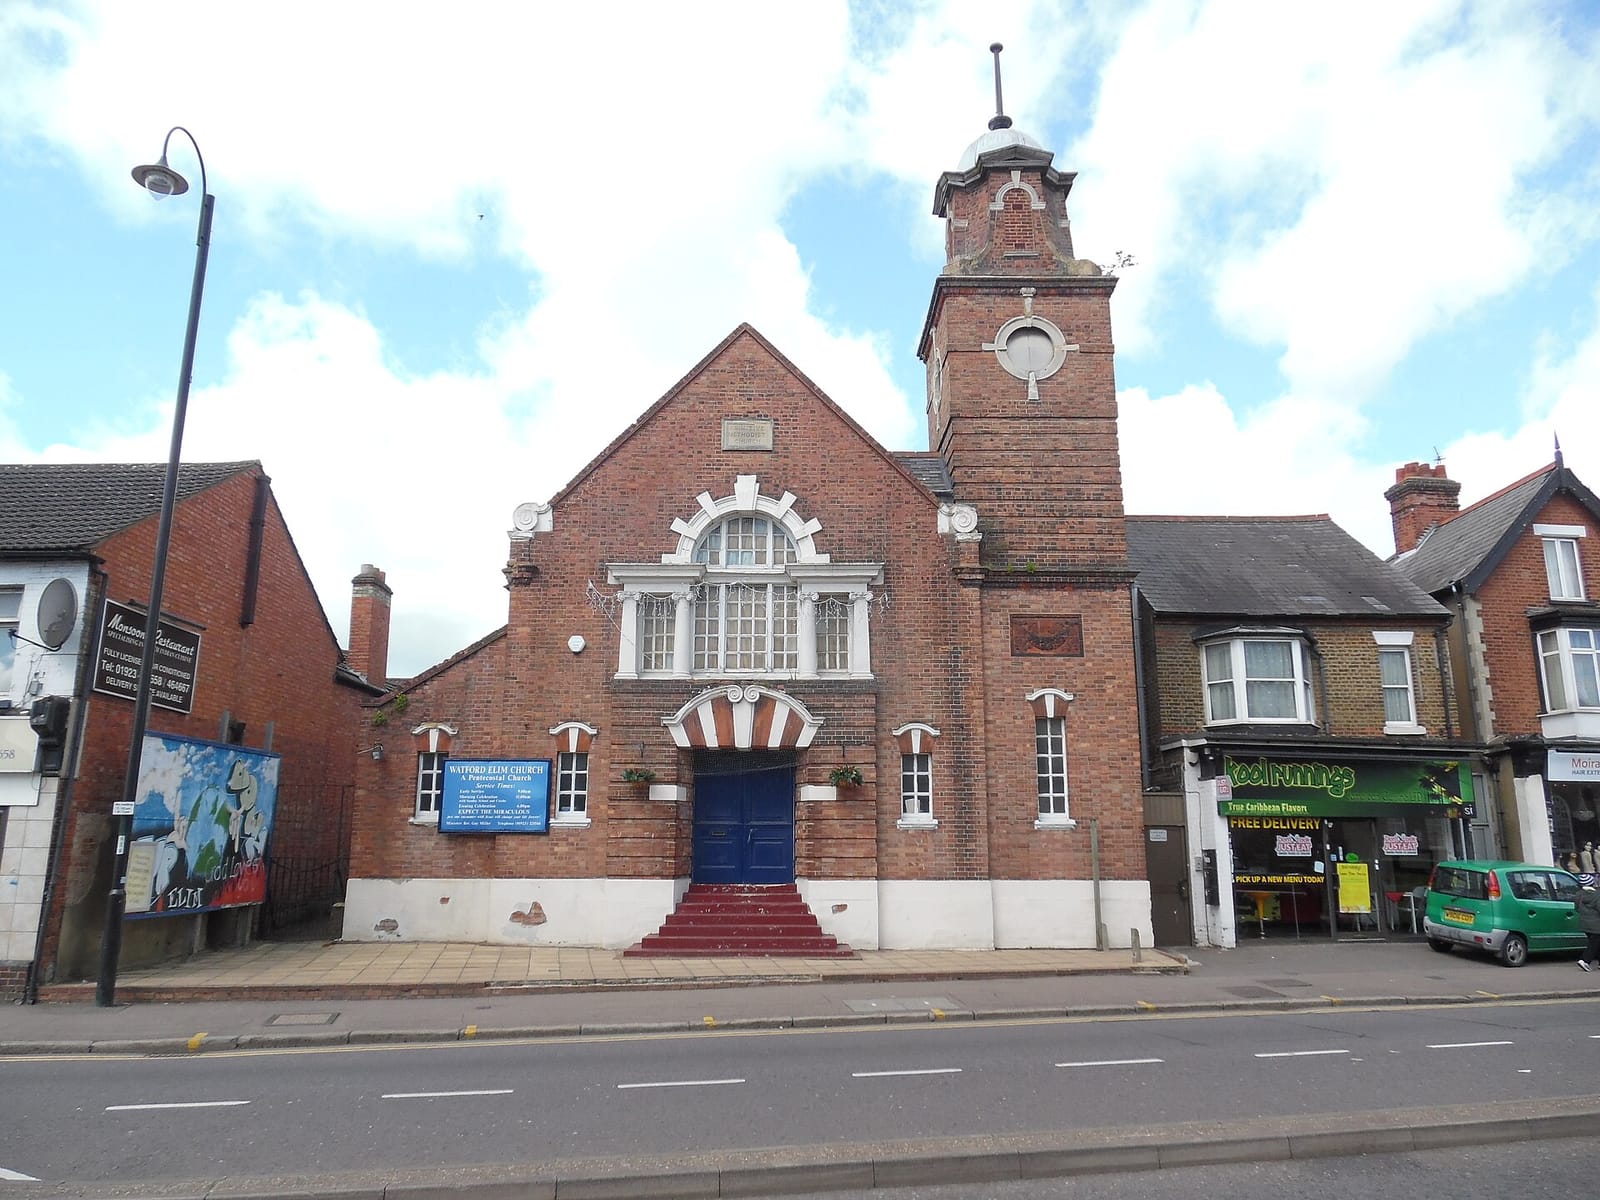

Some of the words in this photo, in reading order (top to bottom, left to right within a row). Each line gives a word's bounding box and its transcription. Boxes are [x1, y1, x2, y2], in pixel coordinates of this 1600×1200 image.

[107, 613, 146, 639] Monsoon
[103, 647, 120, 659] FULLY
[120, 651, 142, 666] LICENSE
[101, 659, 114, 673] Tel:
[115, 664, 137, 679] 01923
[105, 676, 132, 690] DELIVERY
[449, 765, 486, 774] WATFORD
[487, 765, 508, 774] ELIM
[510, 765, 544, 774] CHURCH
[1227, 802, 1244, 811] True
[1246, 802, 1280, 812] Caribbean
[1230, 817, 1261, 829] FREE
[1263, 818, 1321, 830] DELIVERY
[1235, 875, 1252, 883] PICK
[1303, 876, 1325, 884] TODAY
